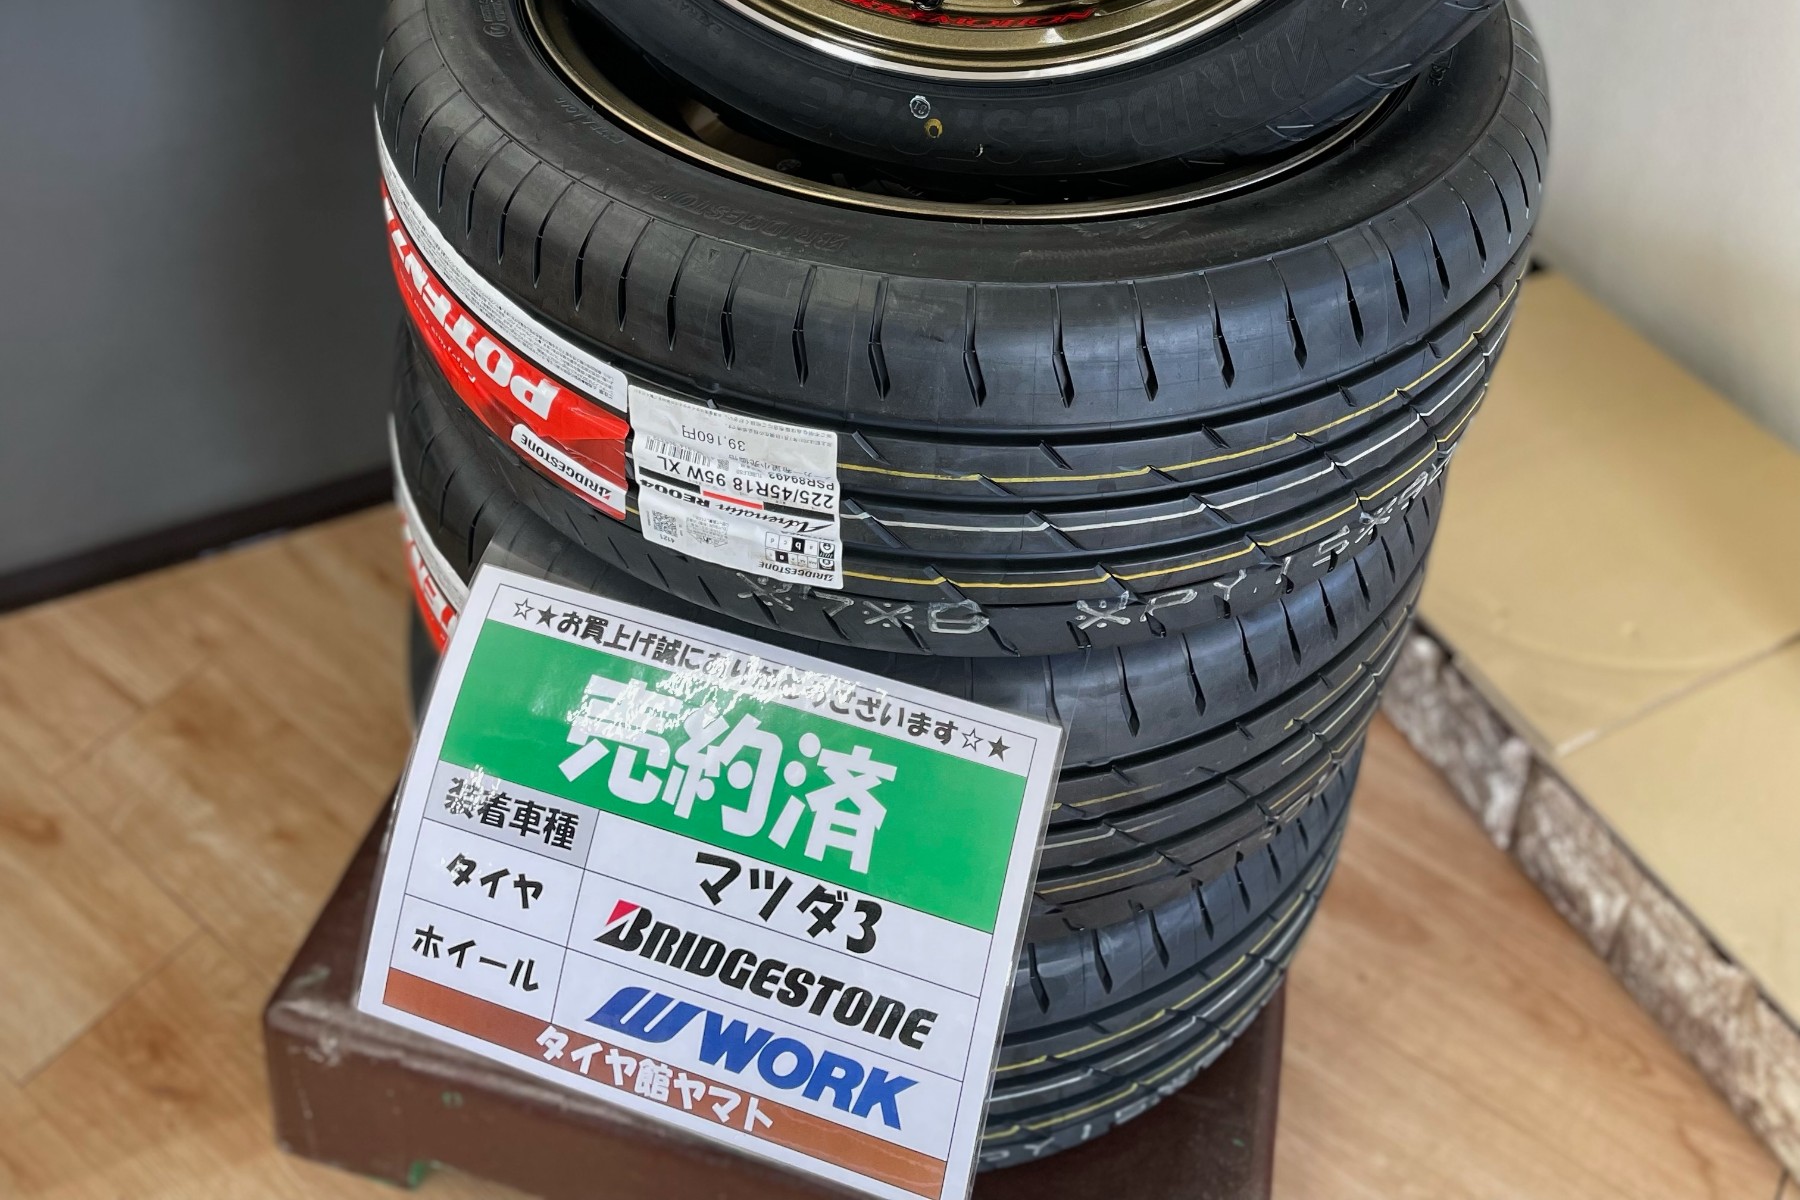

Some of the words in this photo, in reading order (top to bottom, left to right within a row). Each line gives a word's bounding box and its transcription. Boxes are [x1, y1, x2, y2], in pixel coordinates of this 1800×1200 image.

[520, 433, 612, 501] BRIDGESTONE
[657, 455, 681, 472] XL
[681, 424, 746, 452] 39,160円
[639, 479, 710, 508] RE004
[687, 465, 726, 487] 95W
[732, 477, 834, 509] 225/45R18
[716, 503, 833, 533] Adrenalin
[758, 561, 834, 582] BRIDGESTONE
[557, 673, 899, 875] 売約済
[444, 777, 579, 853] 装着車種
[445, 852, 544, 910] タイヤ
[694, 850, 884, 955] マツダ3
[411, 925, 541, 995] ホイール
[594, 898, 939, 1051] BRIDGESTONE
[535, 1024, 774, 1132] タイヤ館ヤマト
[694, 1019, 920, 1132] WORK
